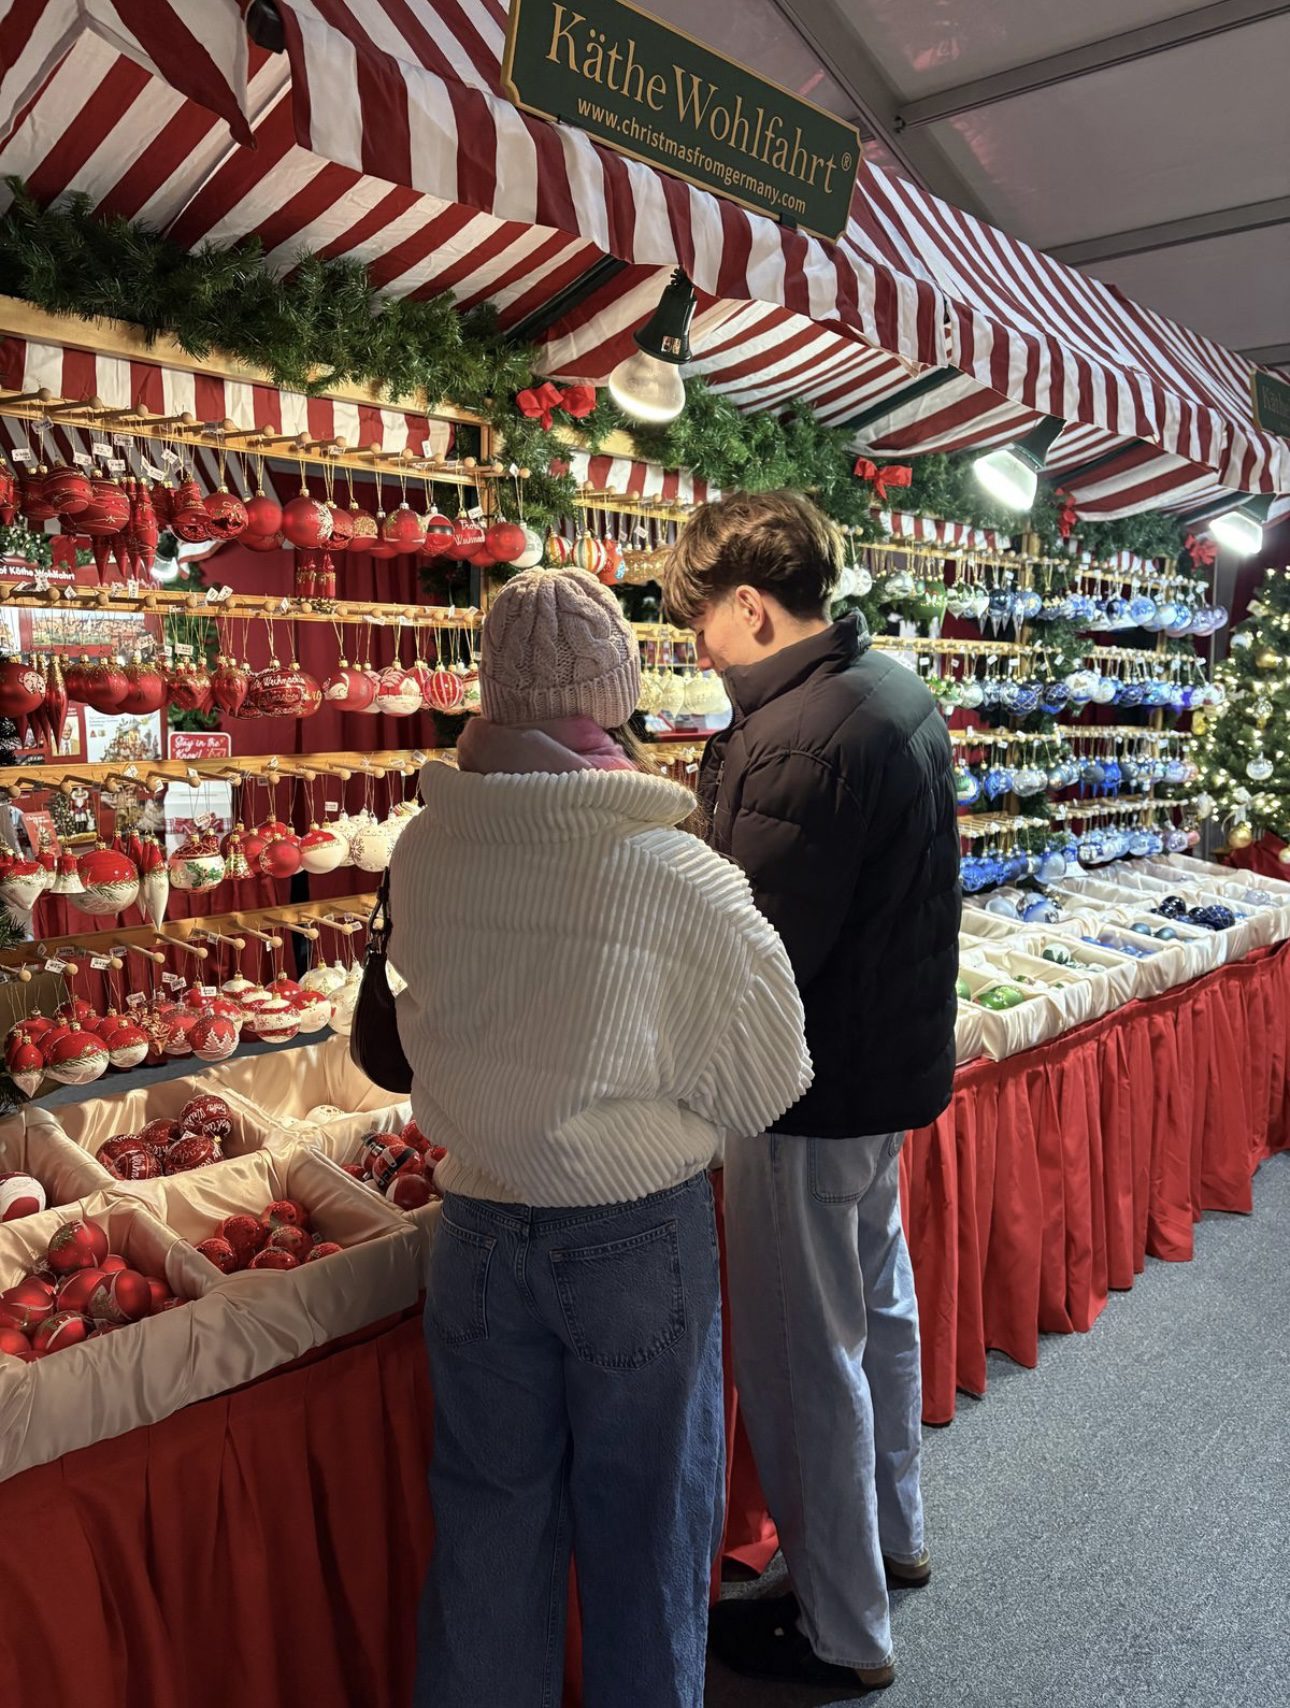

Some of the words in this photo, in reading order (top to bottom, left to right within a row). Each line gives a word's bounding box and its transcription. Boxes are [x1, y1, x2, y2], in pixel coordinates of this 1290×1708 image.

[545, 3, 667, 112] Käthe
[577, 97, 807, 215] www.christmasfromgermany.com
[195, 739, 207, 747] in
